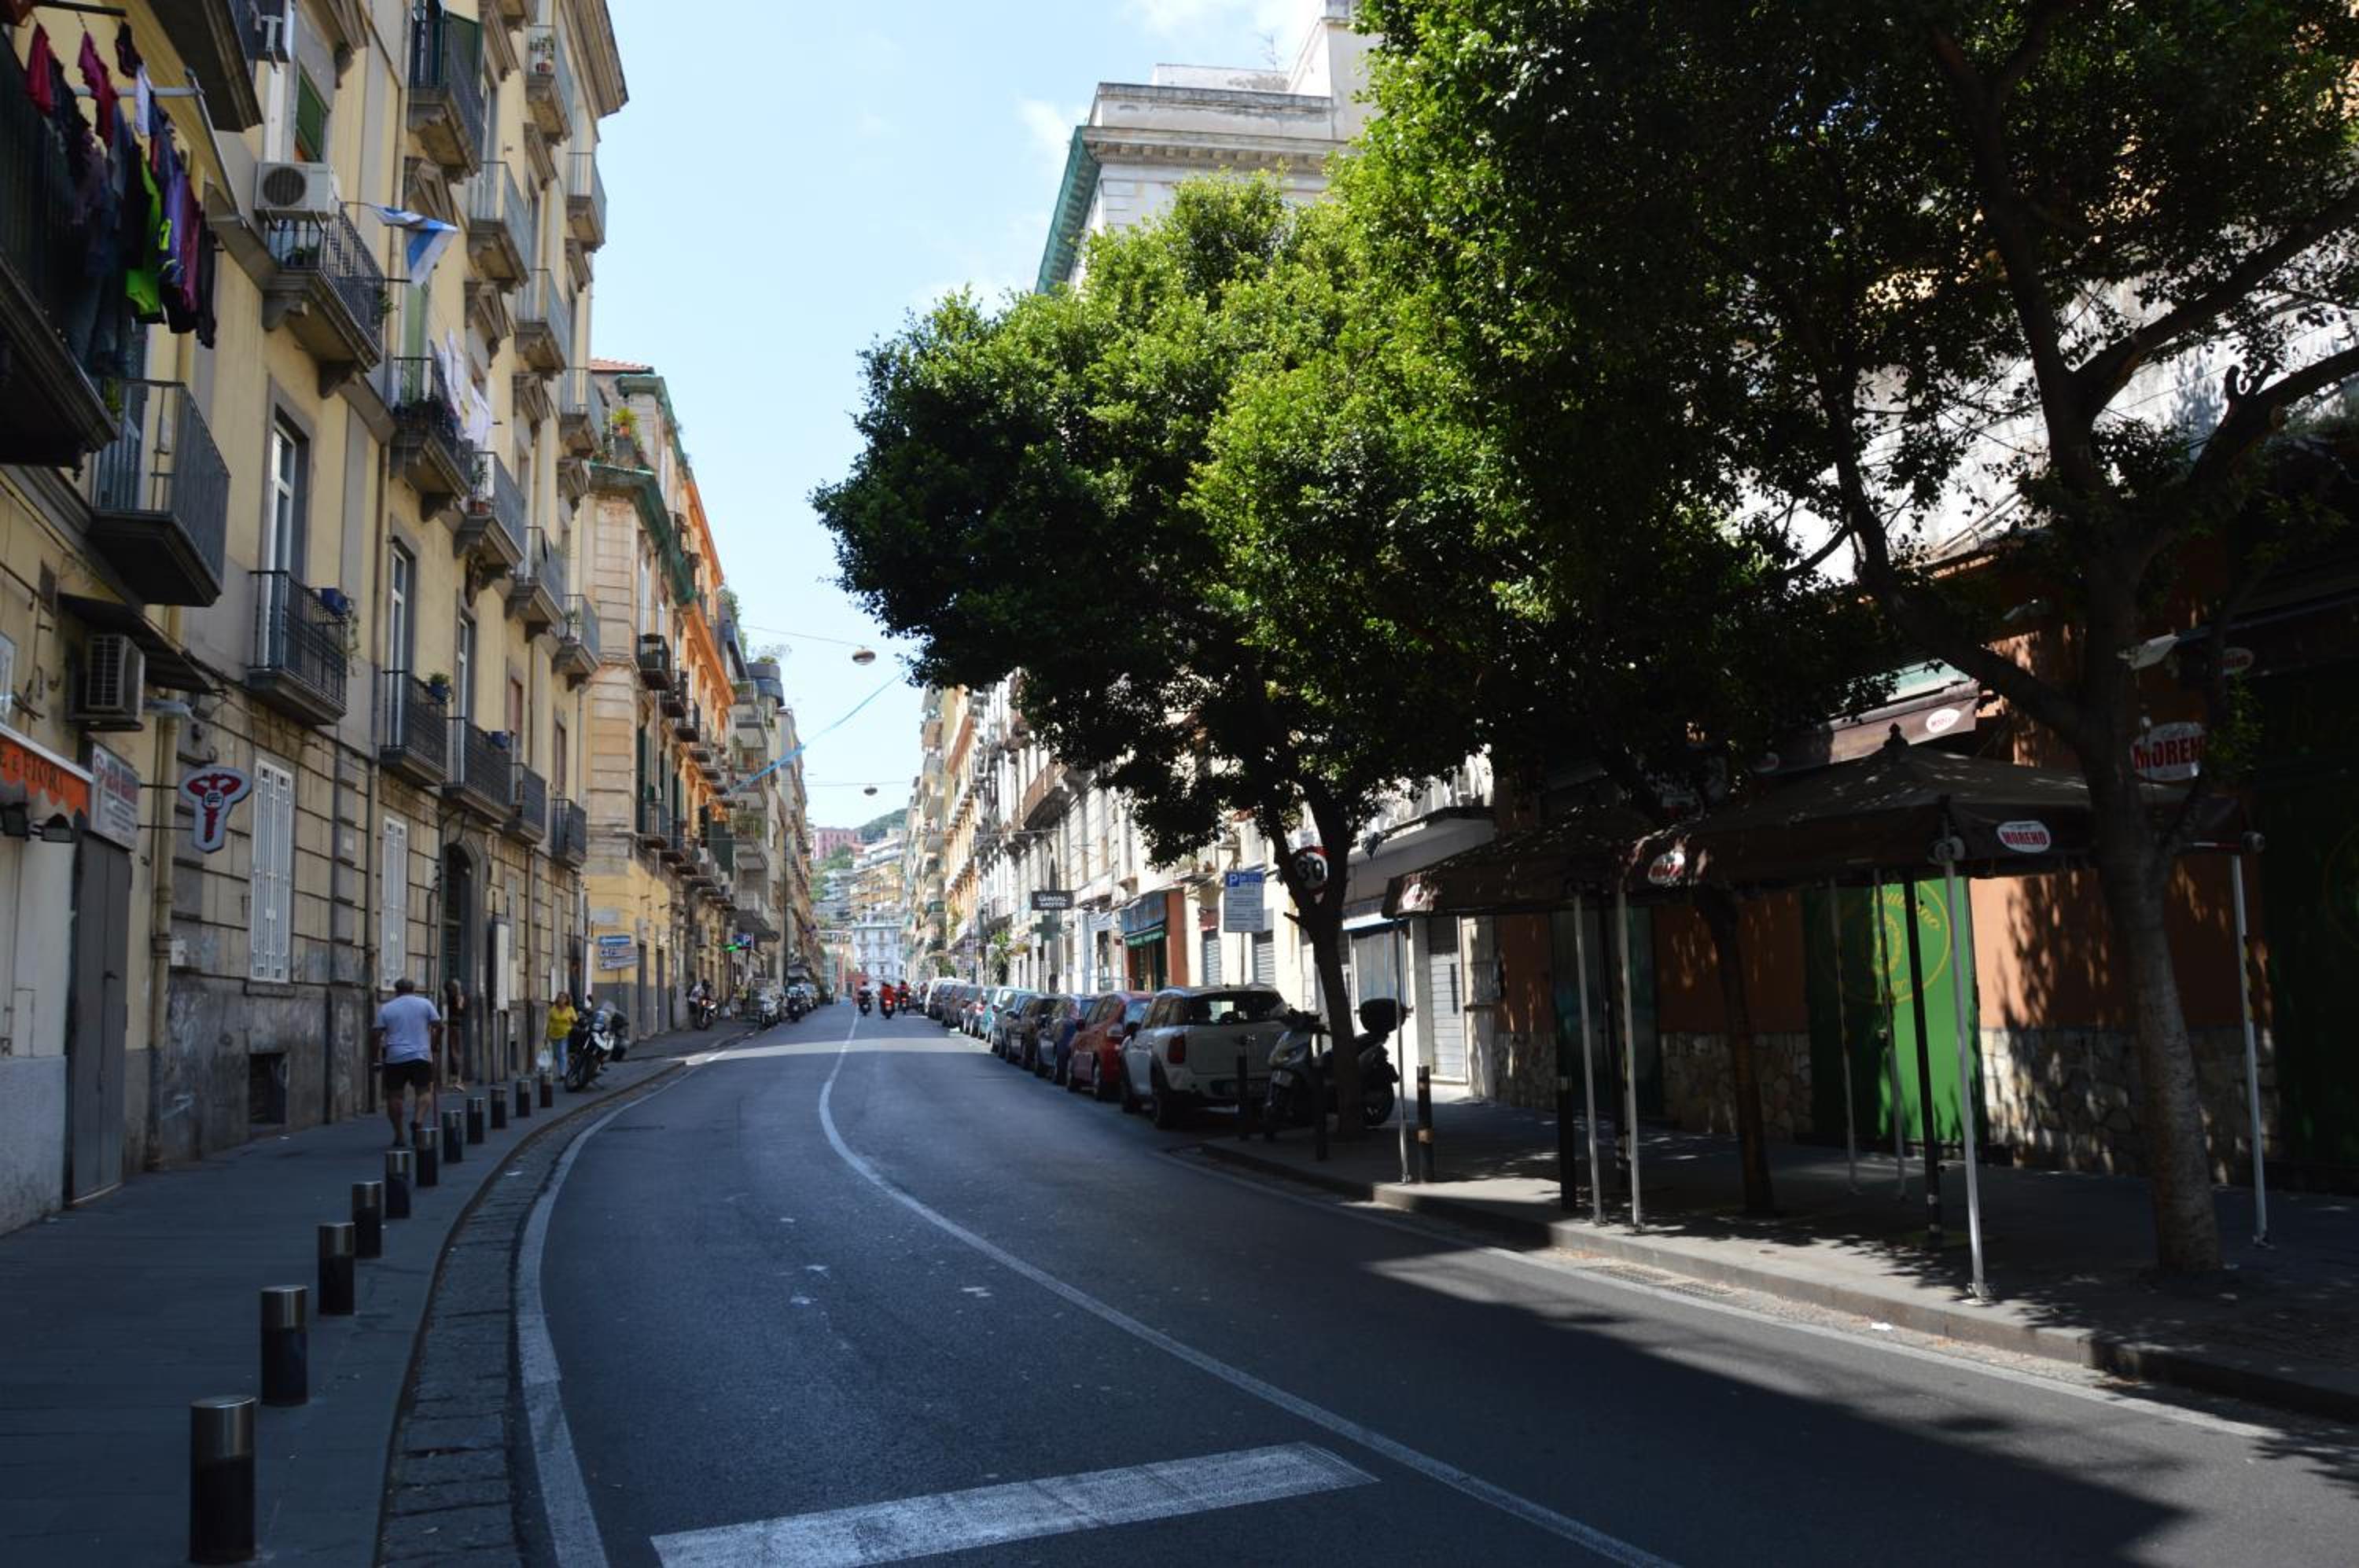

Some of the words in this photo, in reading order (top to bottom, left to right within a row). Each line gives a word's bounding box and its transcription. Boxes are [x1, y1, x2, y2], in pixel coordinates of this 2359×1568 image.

[2133, 735, 2206, 770] MOREN
[2000, 830, 2048, 845] MORENO
[1296, 859, 1324, 882] 30
[1229, 874, 1238, 887] P
